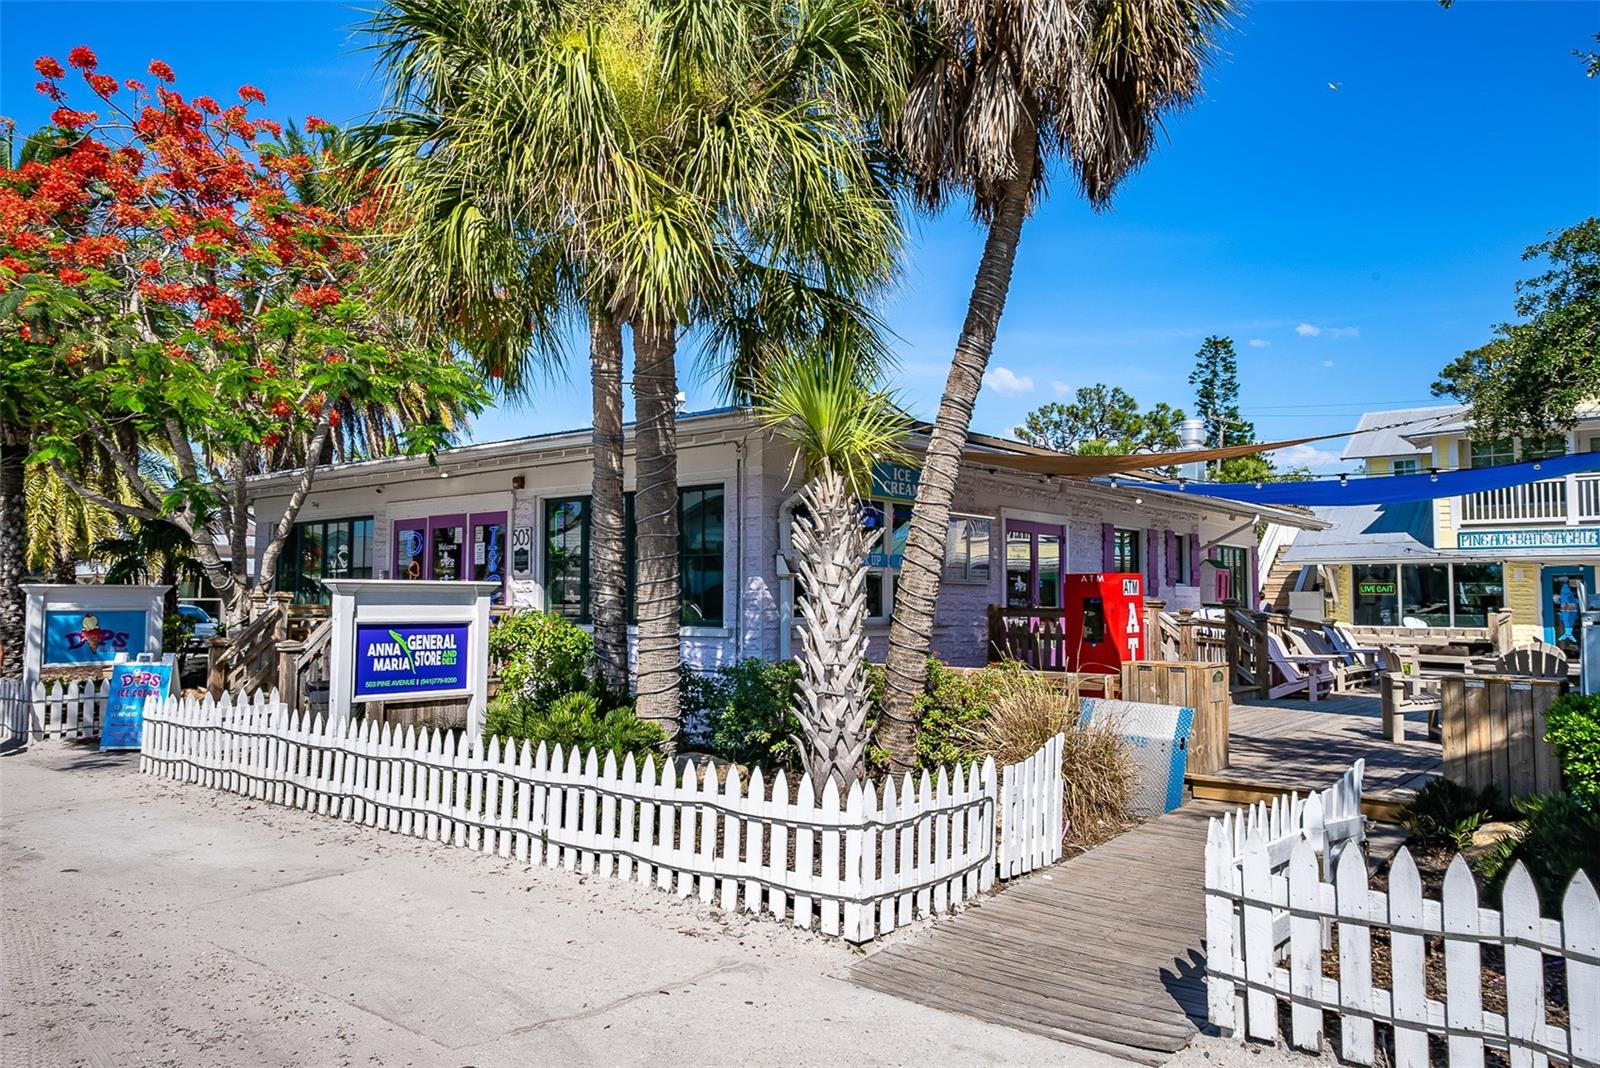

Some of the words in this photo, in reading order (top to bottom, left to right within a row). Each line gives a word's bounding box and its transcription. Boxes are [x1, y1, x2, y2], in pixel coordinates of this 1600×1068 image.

[894, 467, 911, 482] ICE
[512, 528, 530, 546] 503
[871, 555, 881, 566] UP
[1123, 580, 1138, 594] ATM
[1360, 585, 1376, 593] LIVE
[1377, 585, 1393, 593] BAIT
[407, 634, 457, 650] GENERAL
[367, 643, 401, 657] ANNA
[373, 657, 411, 672] MARIA
[414, 651, 442, 667] STORE
[442, 650, 457, 658] AND
[442, 657, 457, 665] DELI
[365, 680, 376, 688] 503
[376, 680, 391, 688] PINE
[391, 678, 415, 687] AVENUE
[117, 689, 130, 698] ICE
